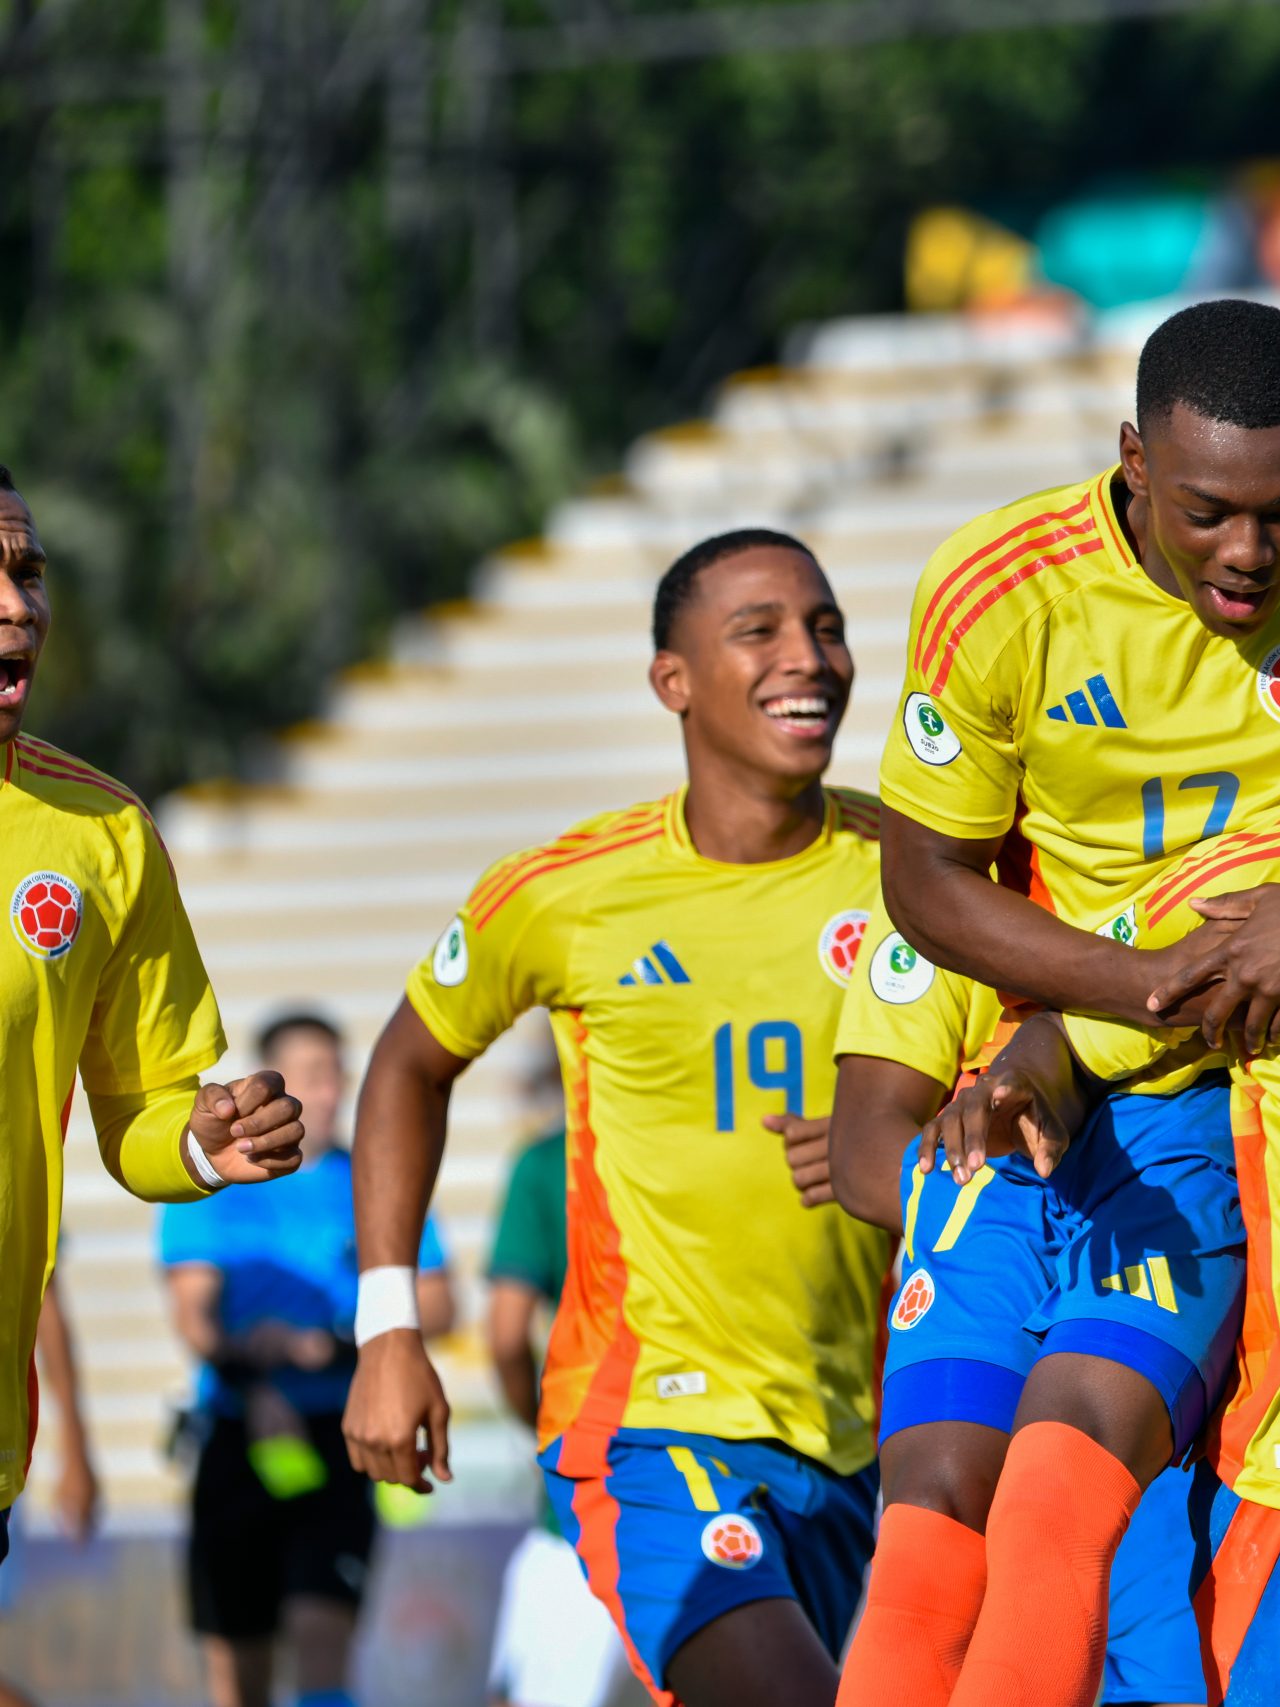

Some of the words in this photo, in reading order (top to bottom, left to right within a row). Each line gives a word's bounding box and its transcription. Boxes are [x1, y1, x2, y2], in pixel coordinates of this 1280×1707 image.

[1141, 770, 1241, 860] 17
[31, 873, 68, 886] COLOMBIANA
[713, 1020, 804, 1132] 19
